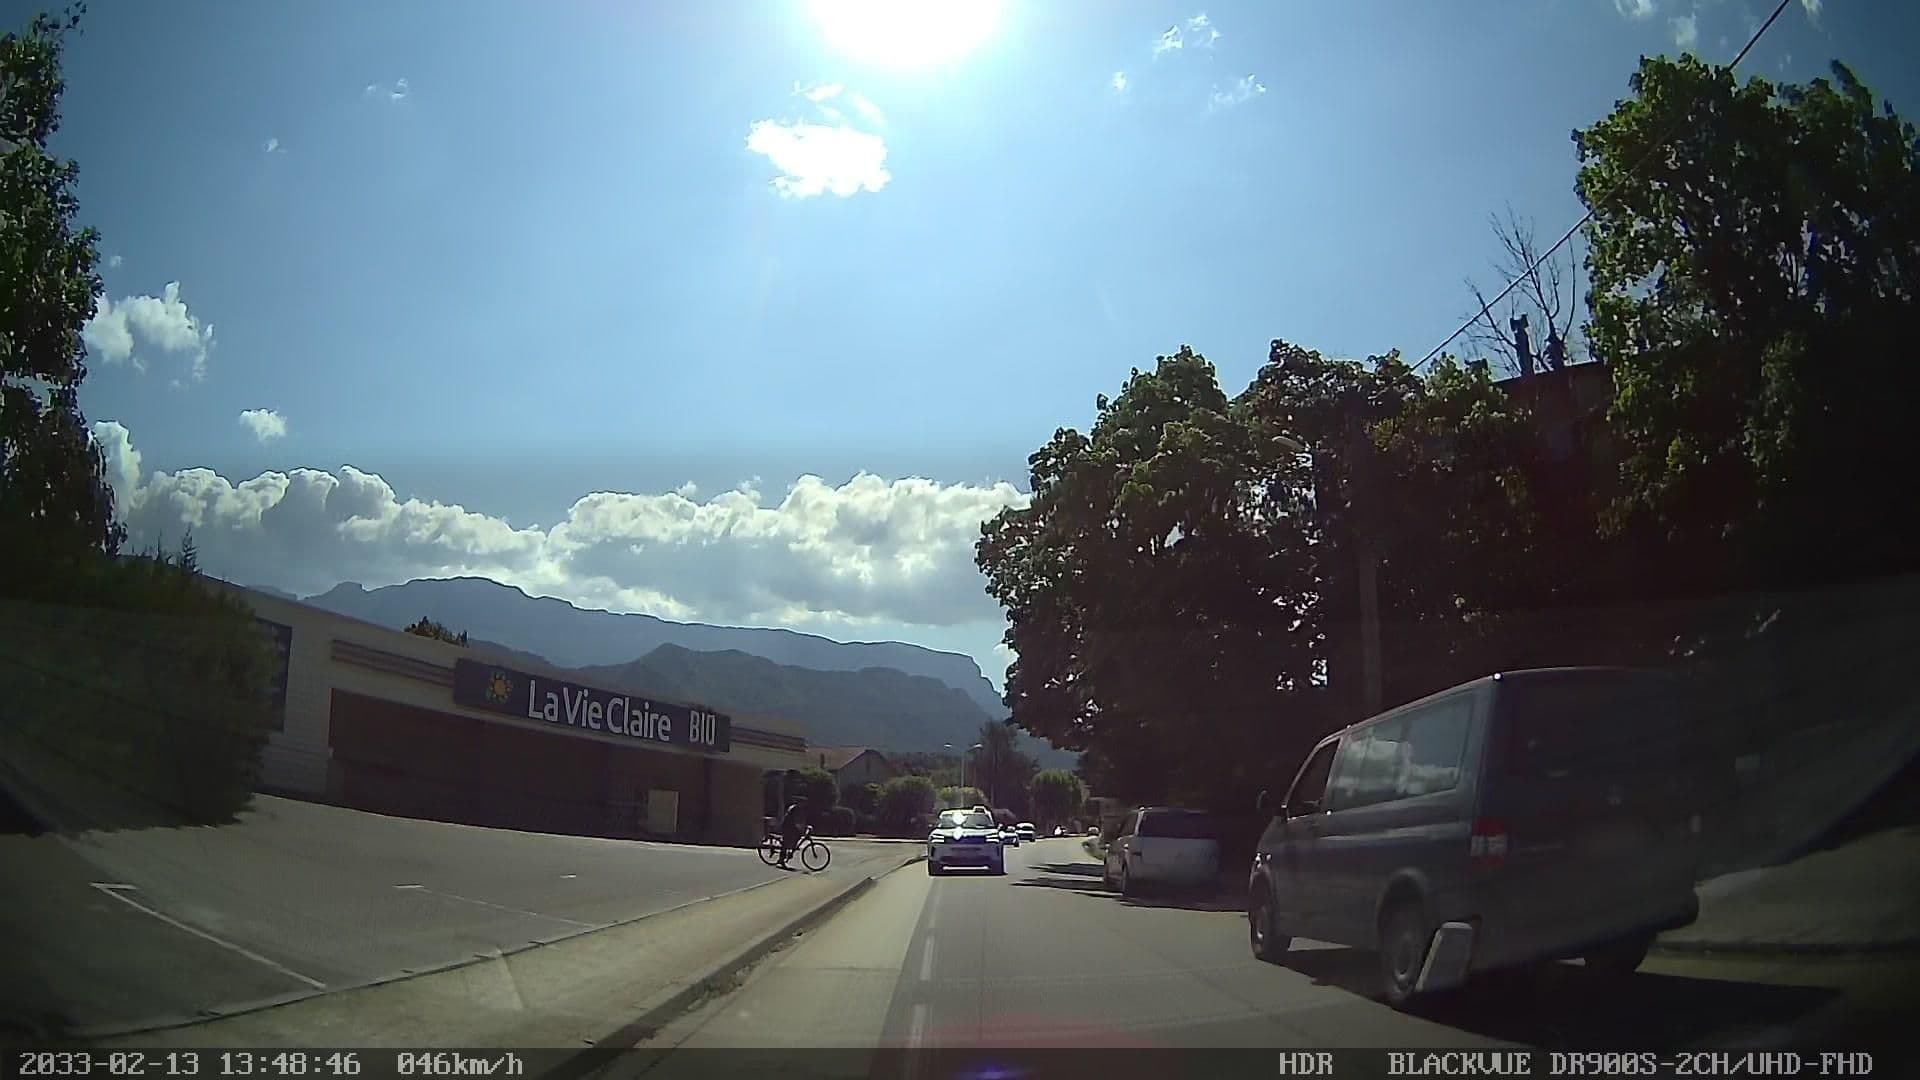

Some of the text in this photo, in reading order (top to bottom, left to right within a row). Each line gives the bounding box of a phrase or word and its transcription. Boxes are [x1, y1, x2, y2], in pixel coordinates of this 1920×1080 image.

[528, 680, 716, 745] La Vie Claire BIO
